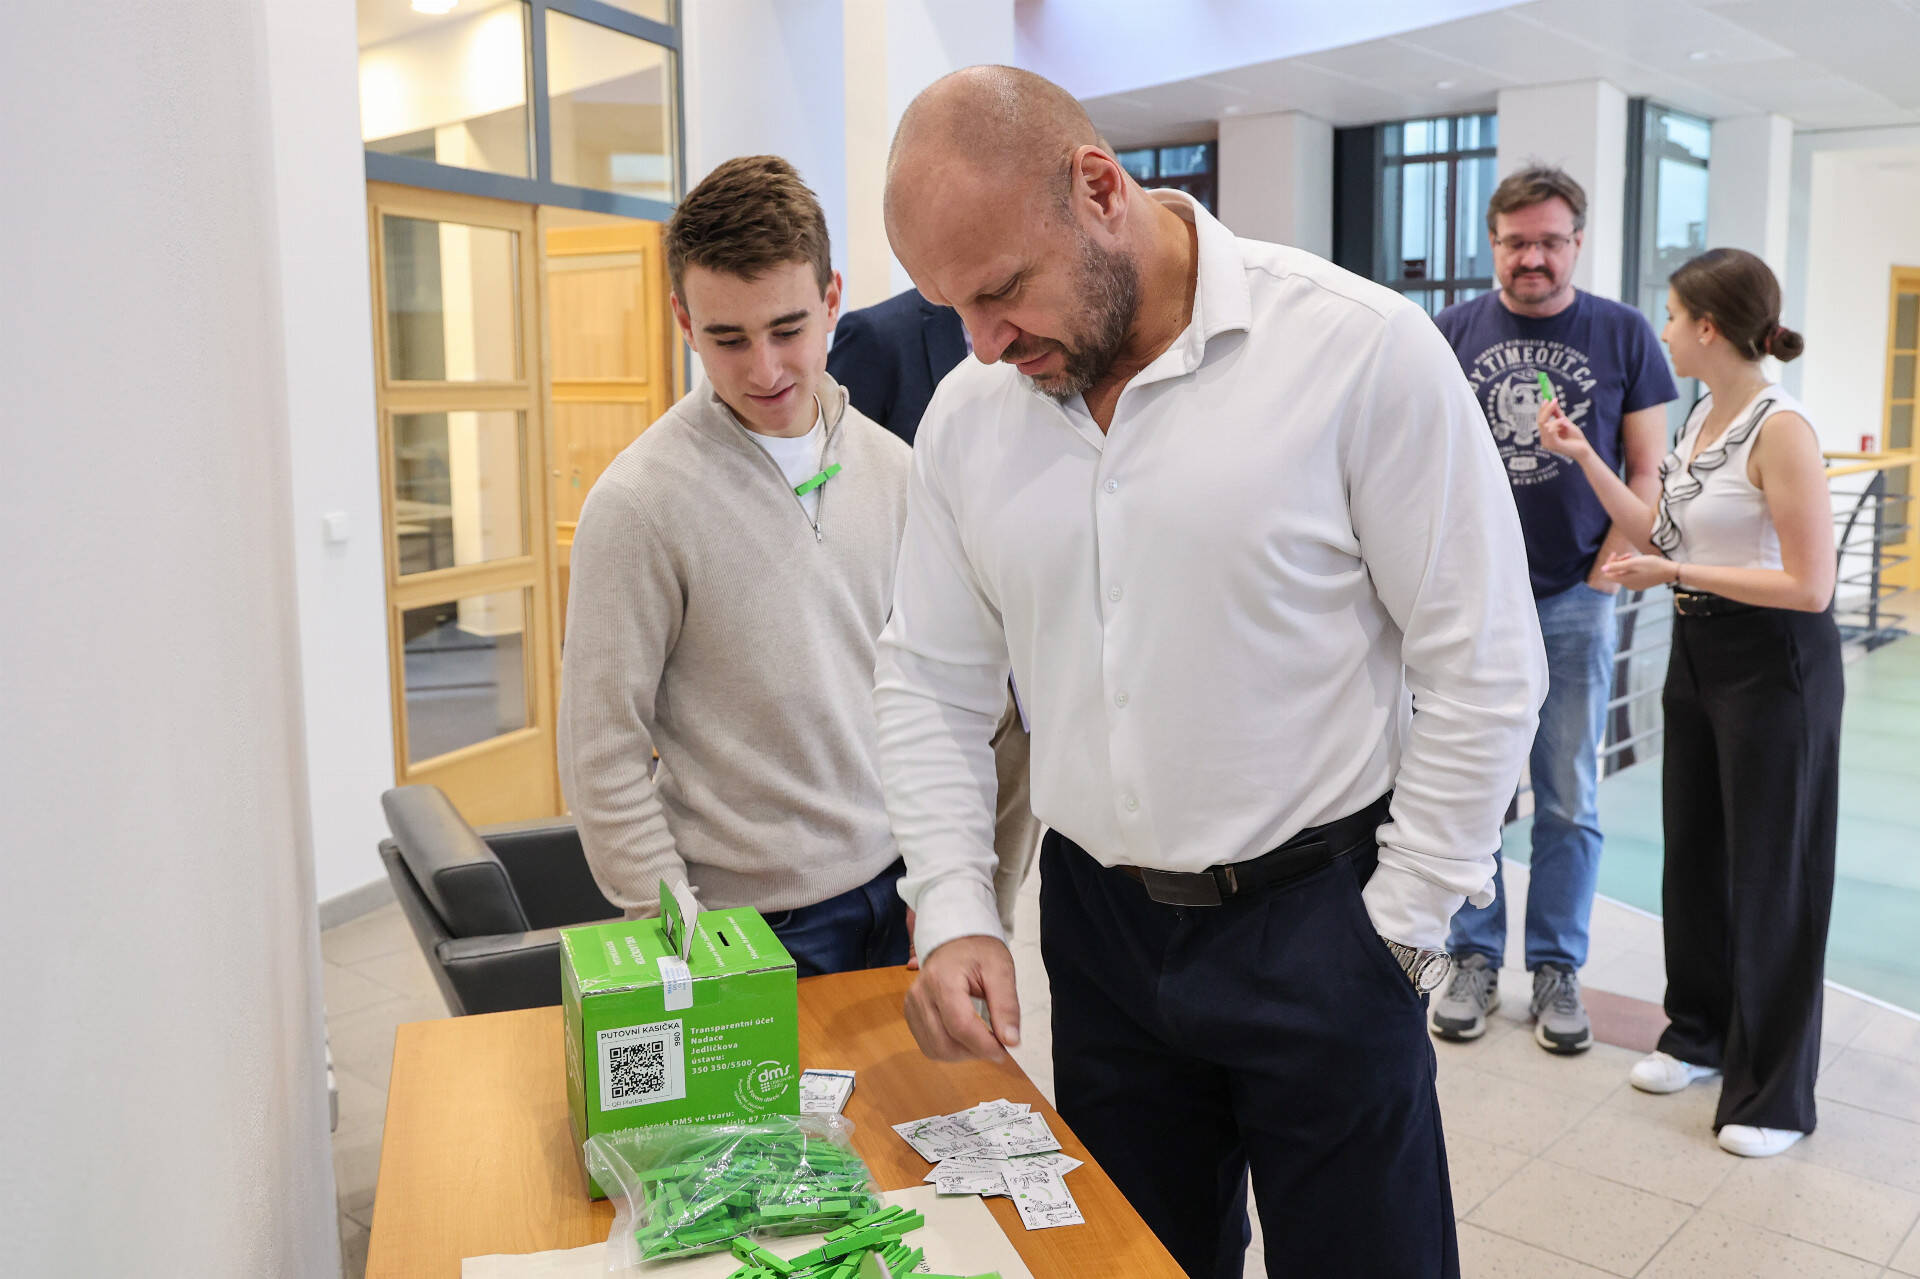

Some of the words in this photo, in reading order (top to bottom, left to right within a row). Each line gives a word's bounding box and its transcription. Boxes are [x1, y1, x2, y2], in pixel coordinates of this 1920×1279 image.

[1483, 346, 1577, 373] TIMEOUT
[601, 1027, 640, 1040] PUTOVNÍ
[642, 1022, 680, 1034] KASIČKA
[690, 1019, 753, 1035] Transparentní
[755, 1017, 774, 1025] účet
[690, 1035, 724, 1045] Nadace
[690, 1043, 738, 1055] Jedličkova
[691, 1055, 725, 1065] ústavu:
[691, 1066, 709, 1075] 350
[711, 1059, 752, 1072] 350/5500
[758, 1064, 790, 1083] dms
[672, 1117, 692, 1126] DMS
[695, 1115, 705, 1123] ve
[707, 1111, 735, 1121] tvaru:
[748, 1115, 759, 1123] 87
